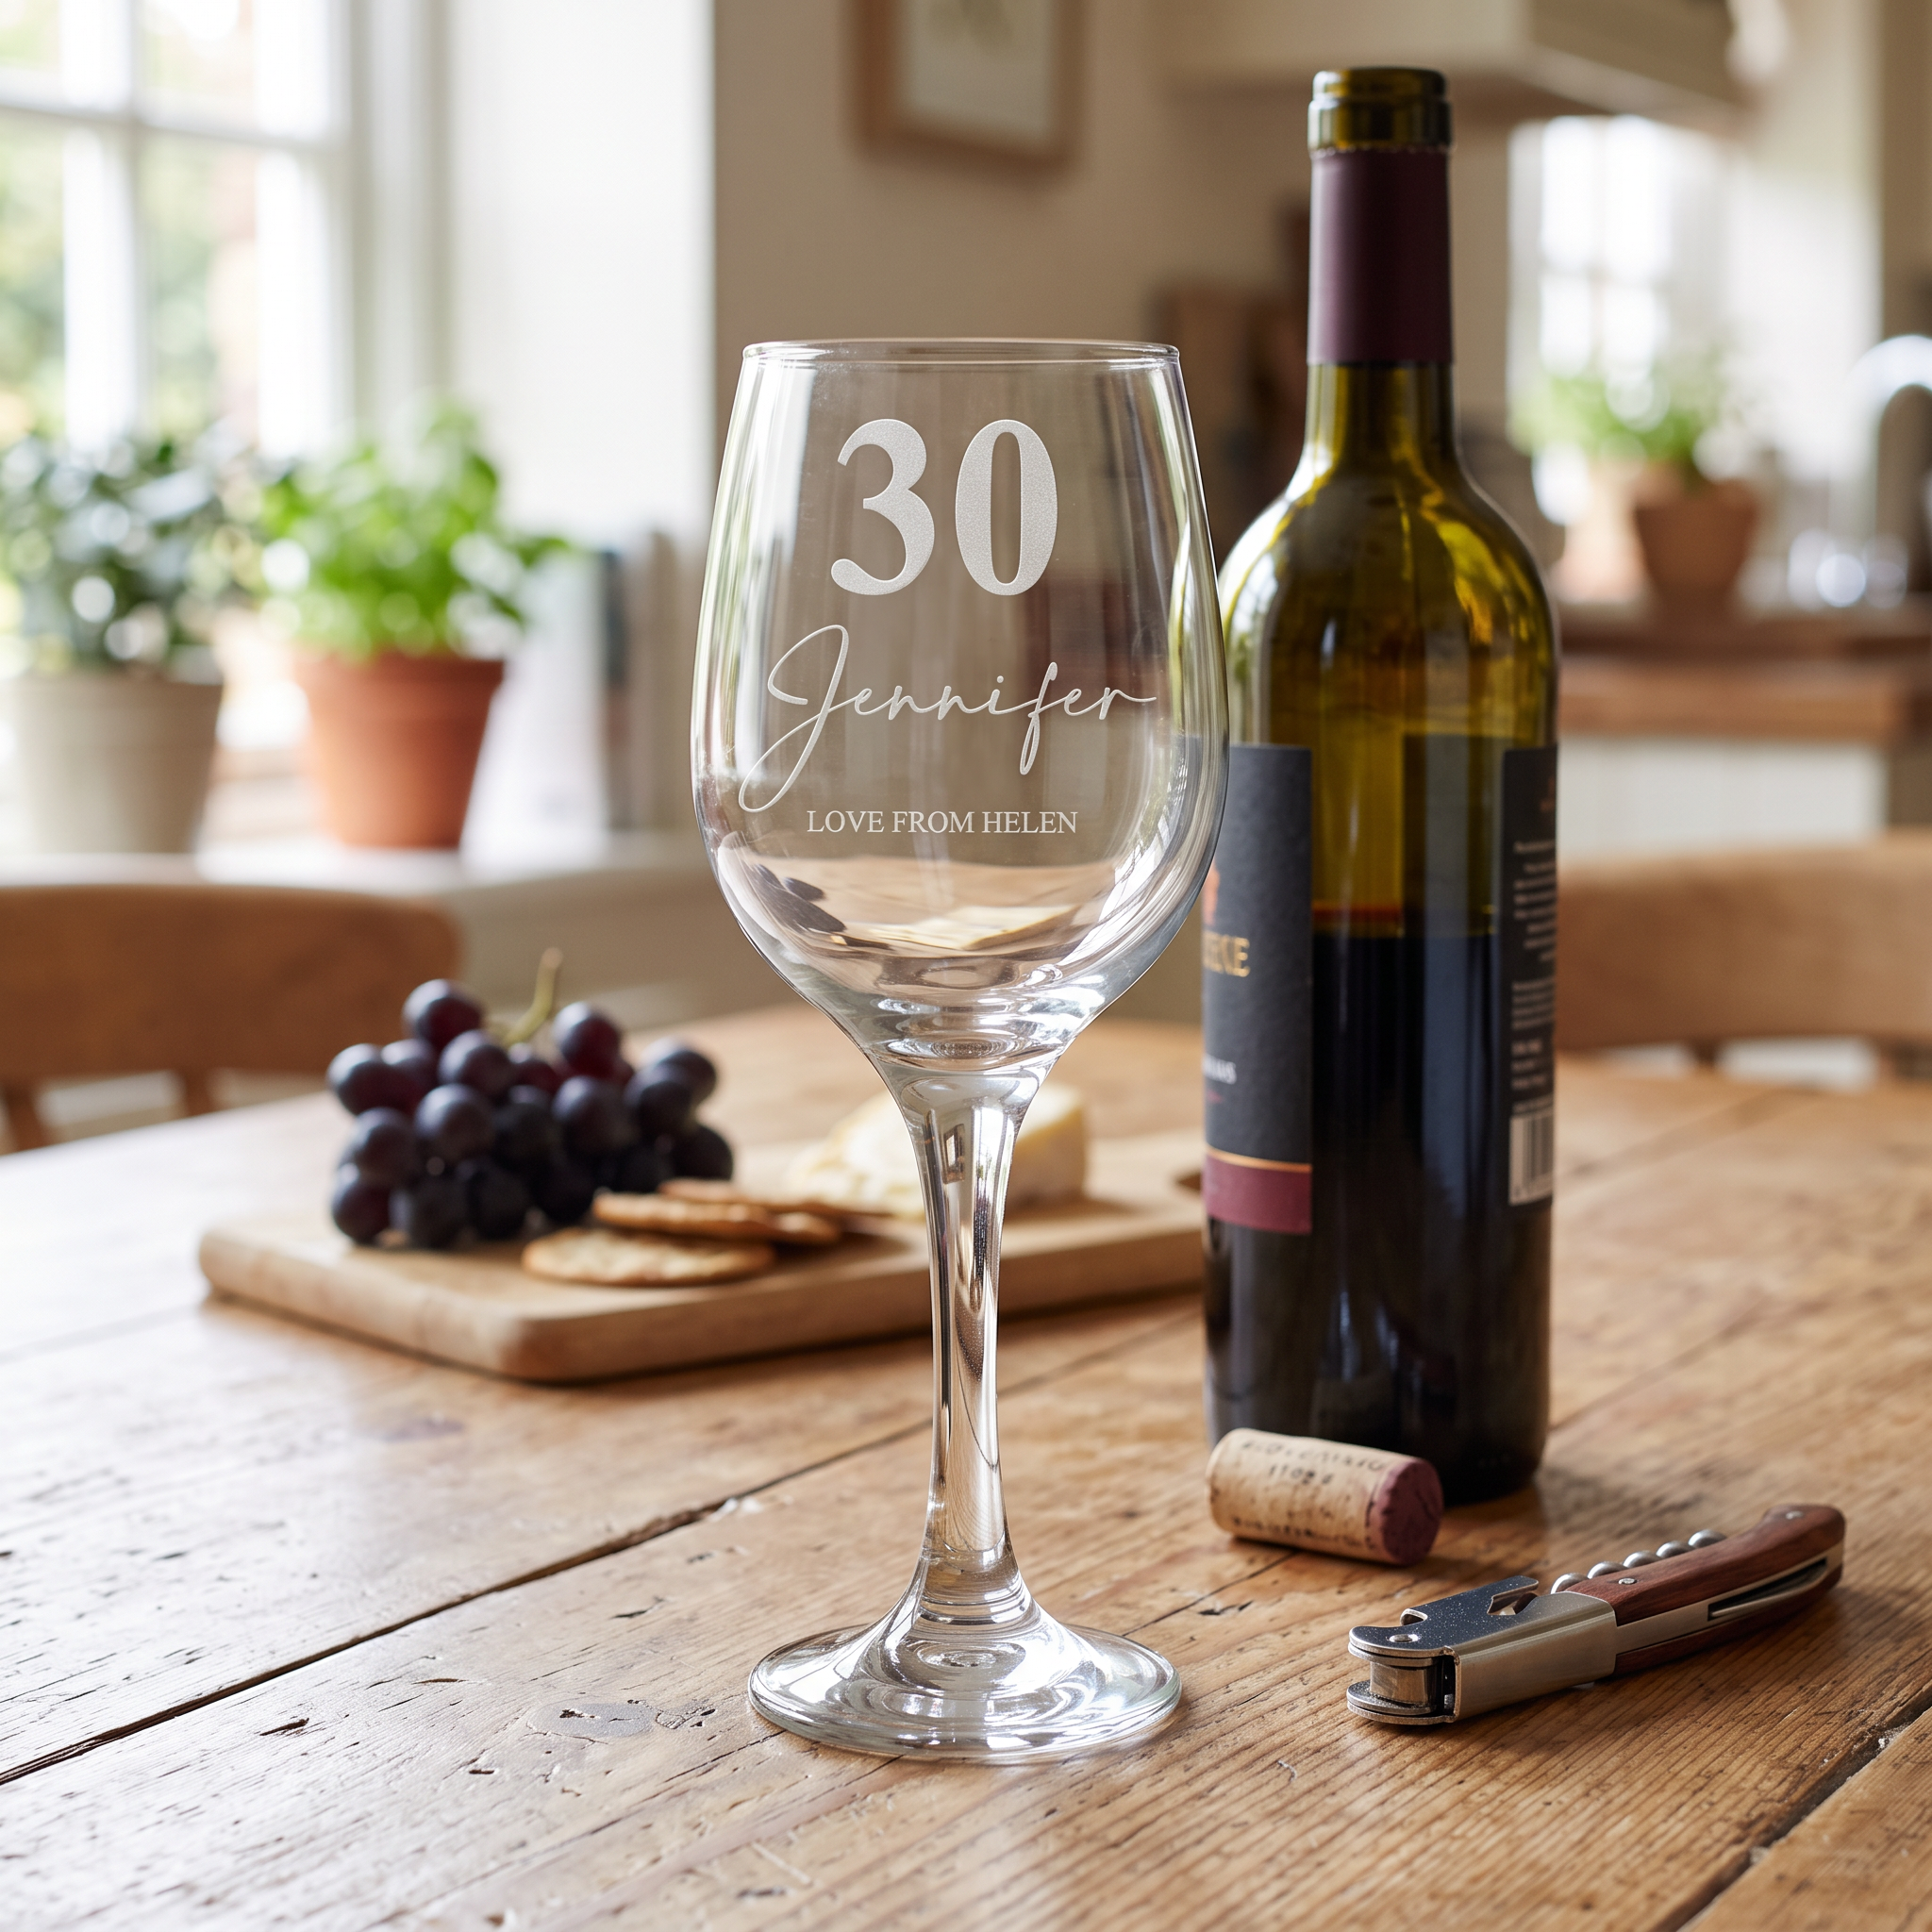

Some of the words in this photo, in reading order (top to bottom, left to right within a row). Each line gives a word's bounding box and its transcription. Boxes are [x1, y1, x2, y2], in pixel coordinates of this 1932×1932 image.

[831, 418, 1058, 596] 30
[738, 624, 1158, 813] Jennifer
[807, 809, 885, 834] LOVE
[891, 810, 975, 834] FROM
[982, 810, 1078, 834] HELEN
